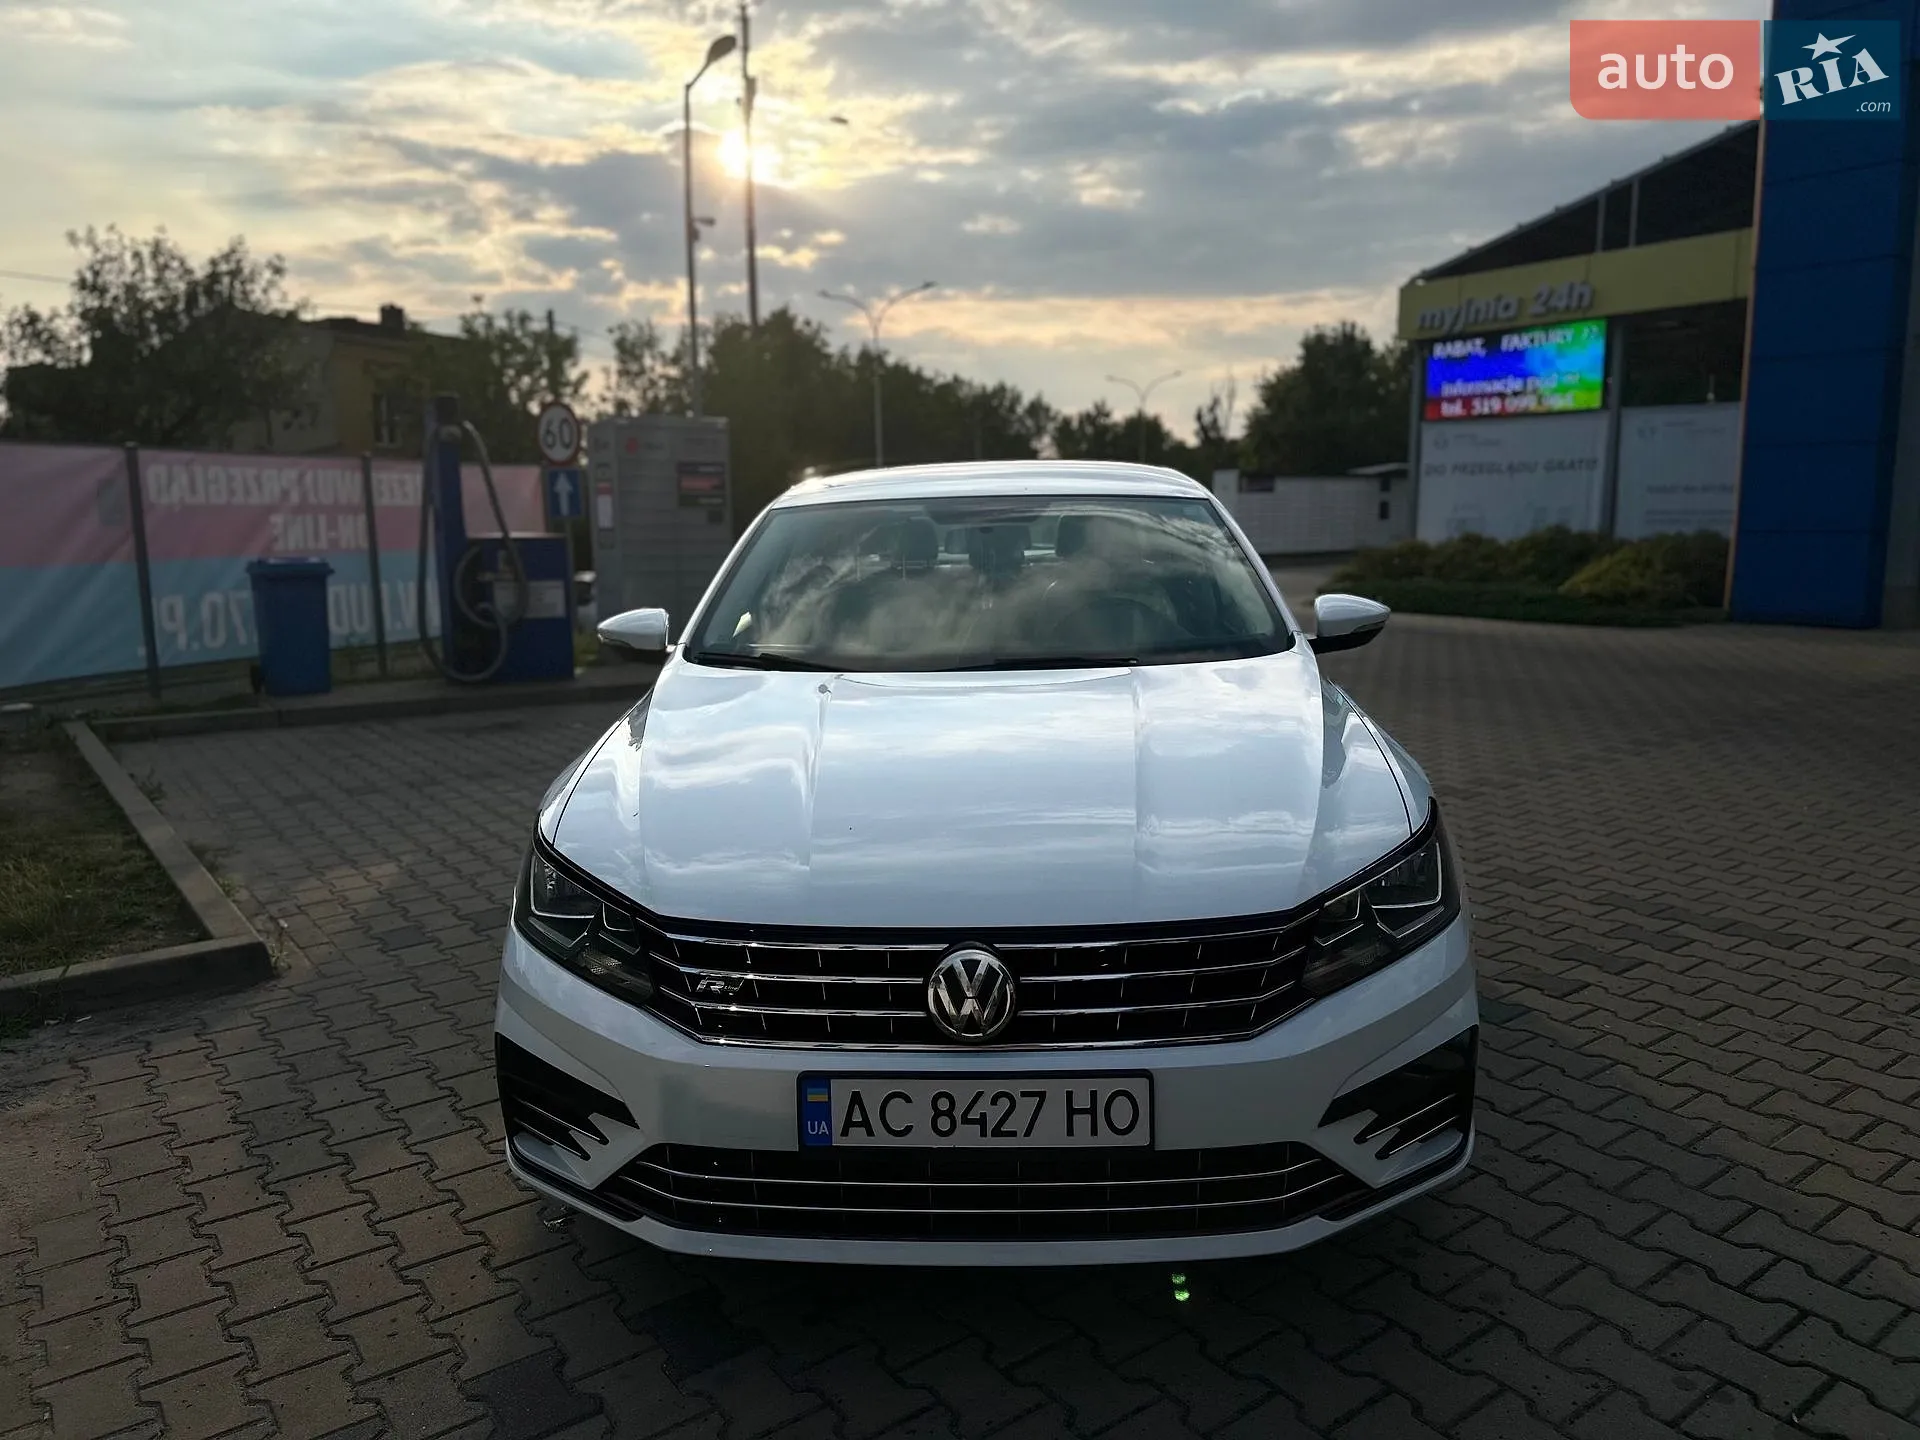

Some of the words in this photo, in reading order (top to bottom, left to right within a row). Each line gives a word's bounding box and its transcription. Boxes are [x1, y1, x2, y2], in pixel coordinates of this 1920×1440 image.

[1418, 294, 1519, 333] myjnia
[1528, 281, 1595, 317] 24h
[546, 418, 572, 450] 60
[807, 1121, 829, 1137] UA
[840, 1090, 915, 1139] AC
[930, 1089, 1048, 1139] 8427
[1065, 1089, 1140, 1138] HO
